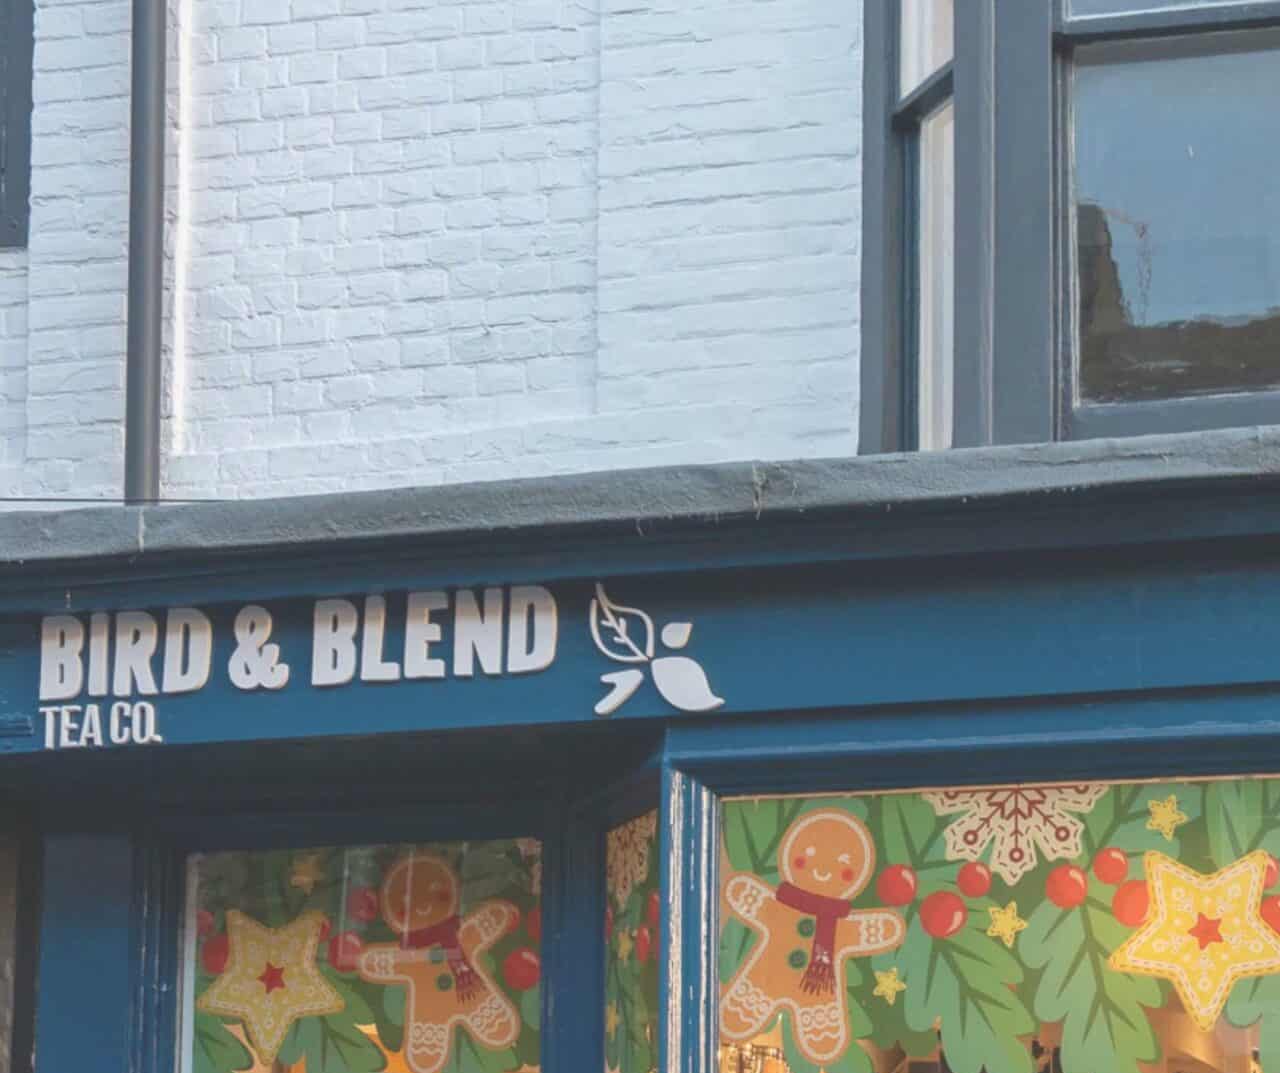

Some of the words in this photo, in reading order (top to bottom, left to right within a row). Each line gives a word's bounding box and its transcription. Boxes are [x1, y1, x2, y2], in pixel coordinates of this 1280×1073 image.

[39, 606, 212, 700] BIRD
[228, 604, 290, 690] &
[311, 584, 558, 686] BLEND
[39, 703, 104, 749] TEA
